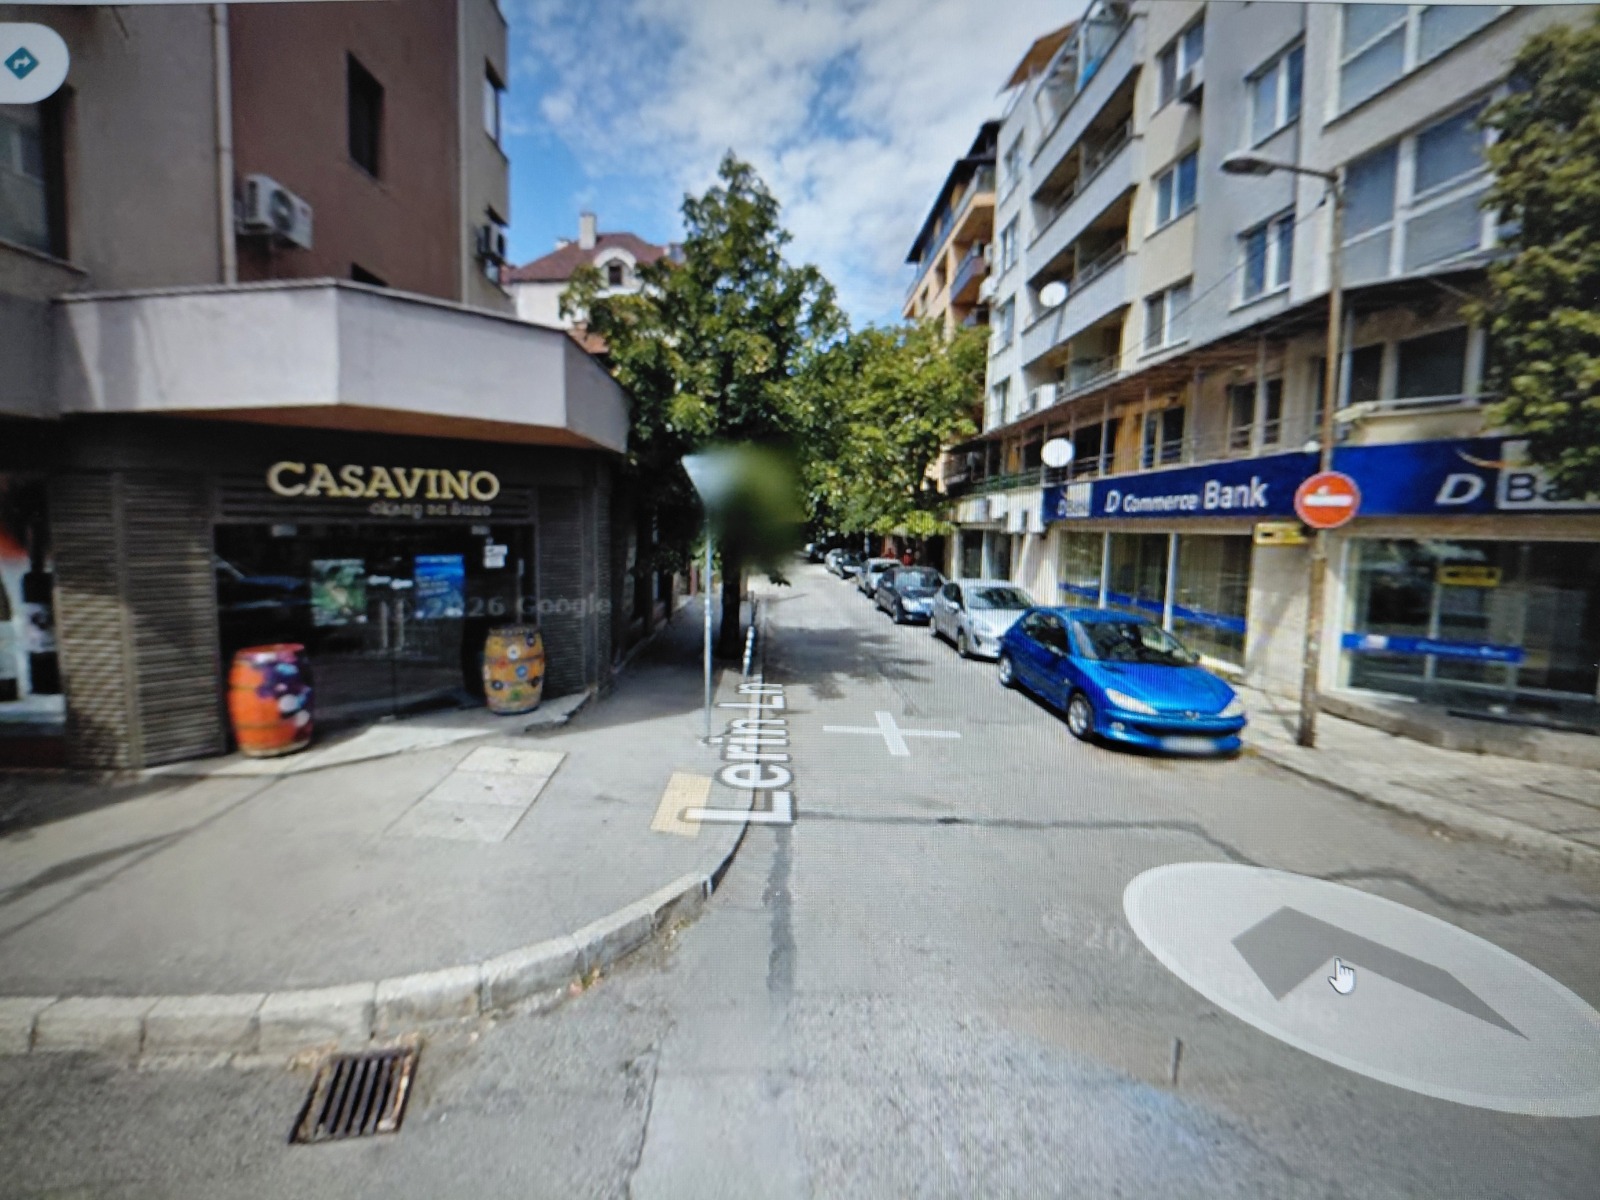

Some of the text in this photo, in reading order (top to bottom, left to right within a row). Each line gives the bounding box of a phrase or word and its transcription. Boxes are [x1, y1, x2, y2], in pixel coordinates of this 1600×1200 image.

[266, 461, 500, 501] CASAVINO
[1103, 475, 1269, 513] D Commerce Bank
[1434, 473, 1486, 505] D
